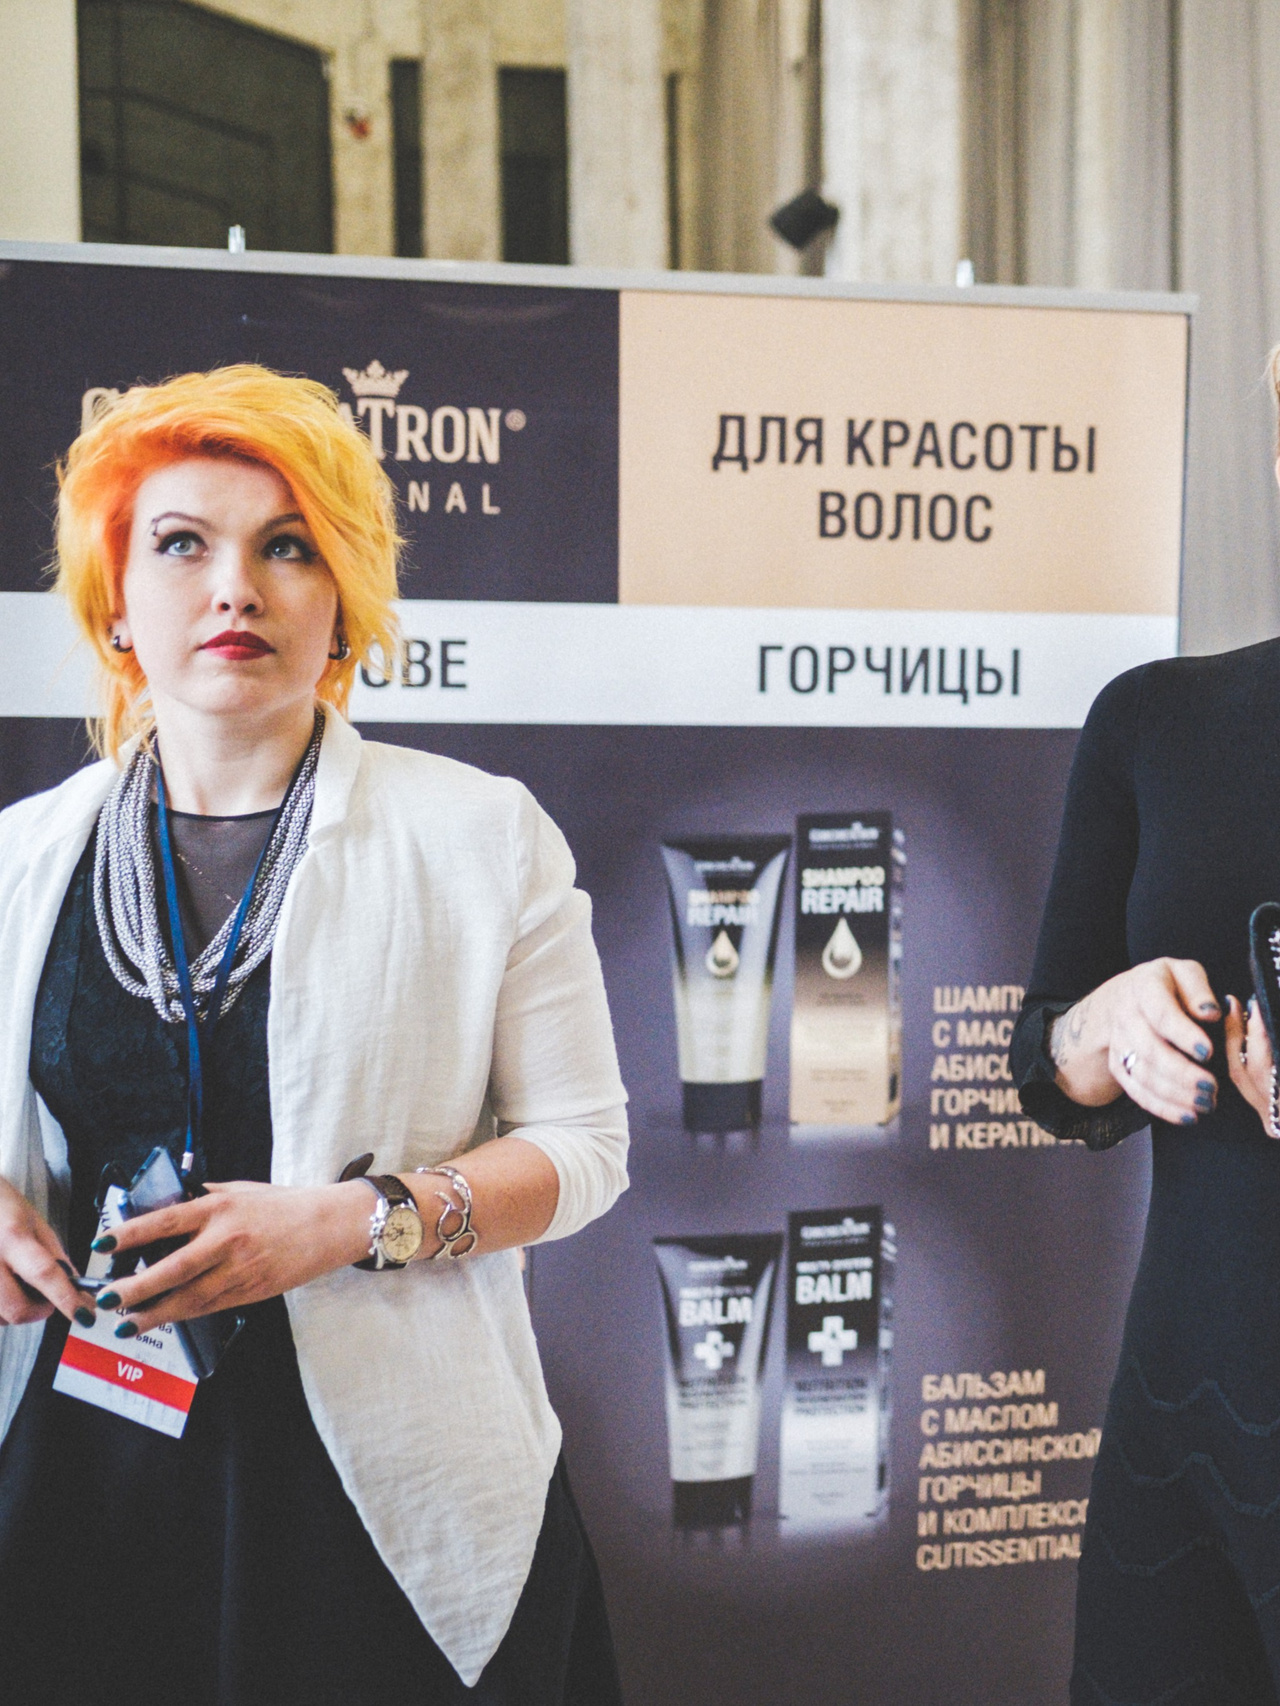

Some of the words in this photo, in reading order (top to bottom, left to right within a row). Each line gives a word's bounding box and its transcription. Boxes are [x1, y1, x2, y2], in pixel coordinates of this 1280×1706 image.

[711, 413, 825, 473] ДЛЯ
[846, 417, 1097, 474] КРАСОТЫ
[818, 491, 993, 542] ВОЛОС
[758, 645, 1021, 704] ГОРЧИЦЫ
[802, 866, 885, 888] SHAMPOO
[687, 904, 760, 927] REPAIR
[801, 886, 884, 914] REPAIR
[931, 1019, 951, 1048] С
[929, 1122, 950, 1150] И
[796, 1270, 872, 1305] BALM
[679, 1296, 753, 1328] BALM
[117, 1361, 144, 1382] VIP
[921, 1368, 1046, 1401] БАЛЬЗАМ
[920, 1408, 940, 1436] С
[944, 1401, 1059, 1434] МАСЛОМ
[918, 1427, 1103, 1470] АБИССИНСКОЙ
[918, 1469, 1042, 1503] ГОРЧИЦЫ
[917, 1509, 938, 1537] И
